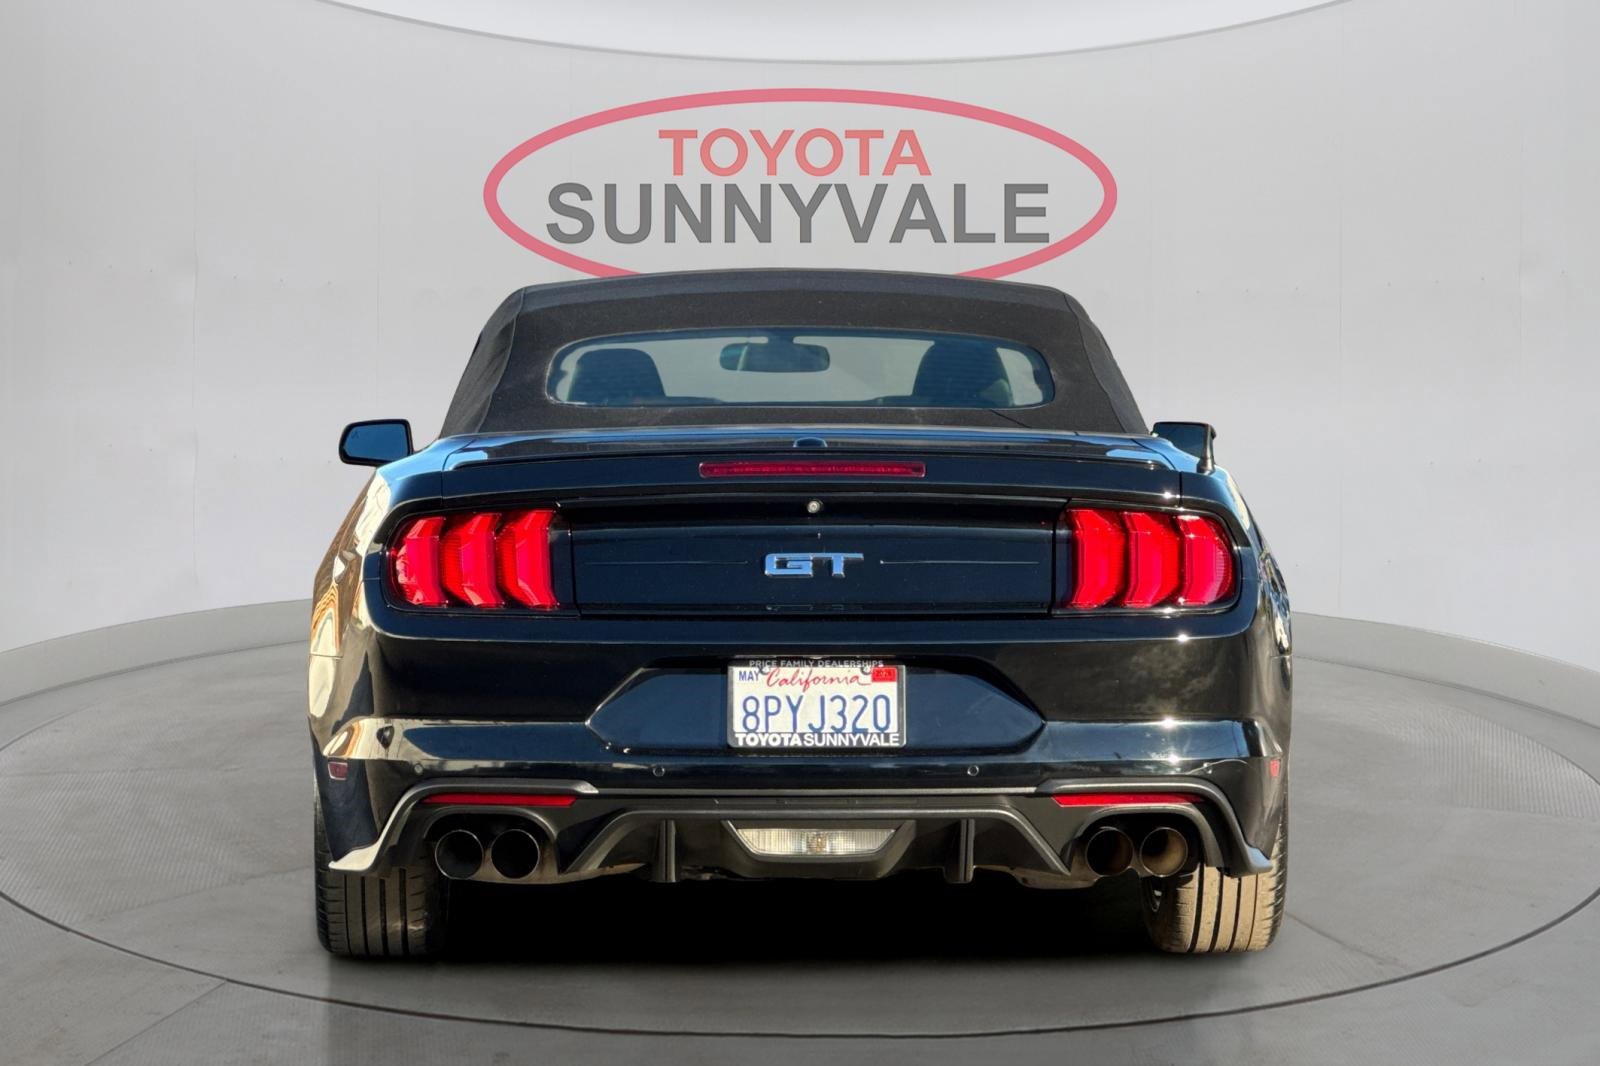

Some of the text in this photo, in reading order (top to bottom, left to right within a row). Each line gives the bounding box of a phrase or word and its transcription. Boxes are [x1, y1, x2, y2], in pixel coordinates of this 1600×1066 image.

[658, 128, 932, 177] TOYOTA
[546, 182, 1051, 244] SUNNYVALE
[765, 552, 864, 577] GT
[738, 671, 760, 682] MAY
[749, 660, 884, 668] PRICE FAMILY DEALERSHIPS
[766, 668, 871, 693] California
[742, 694, 891, 733] 8PYJ320
